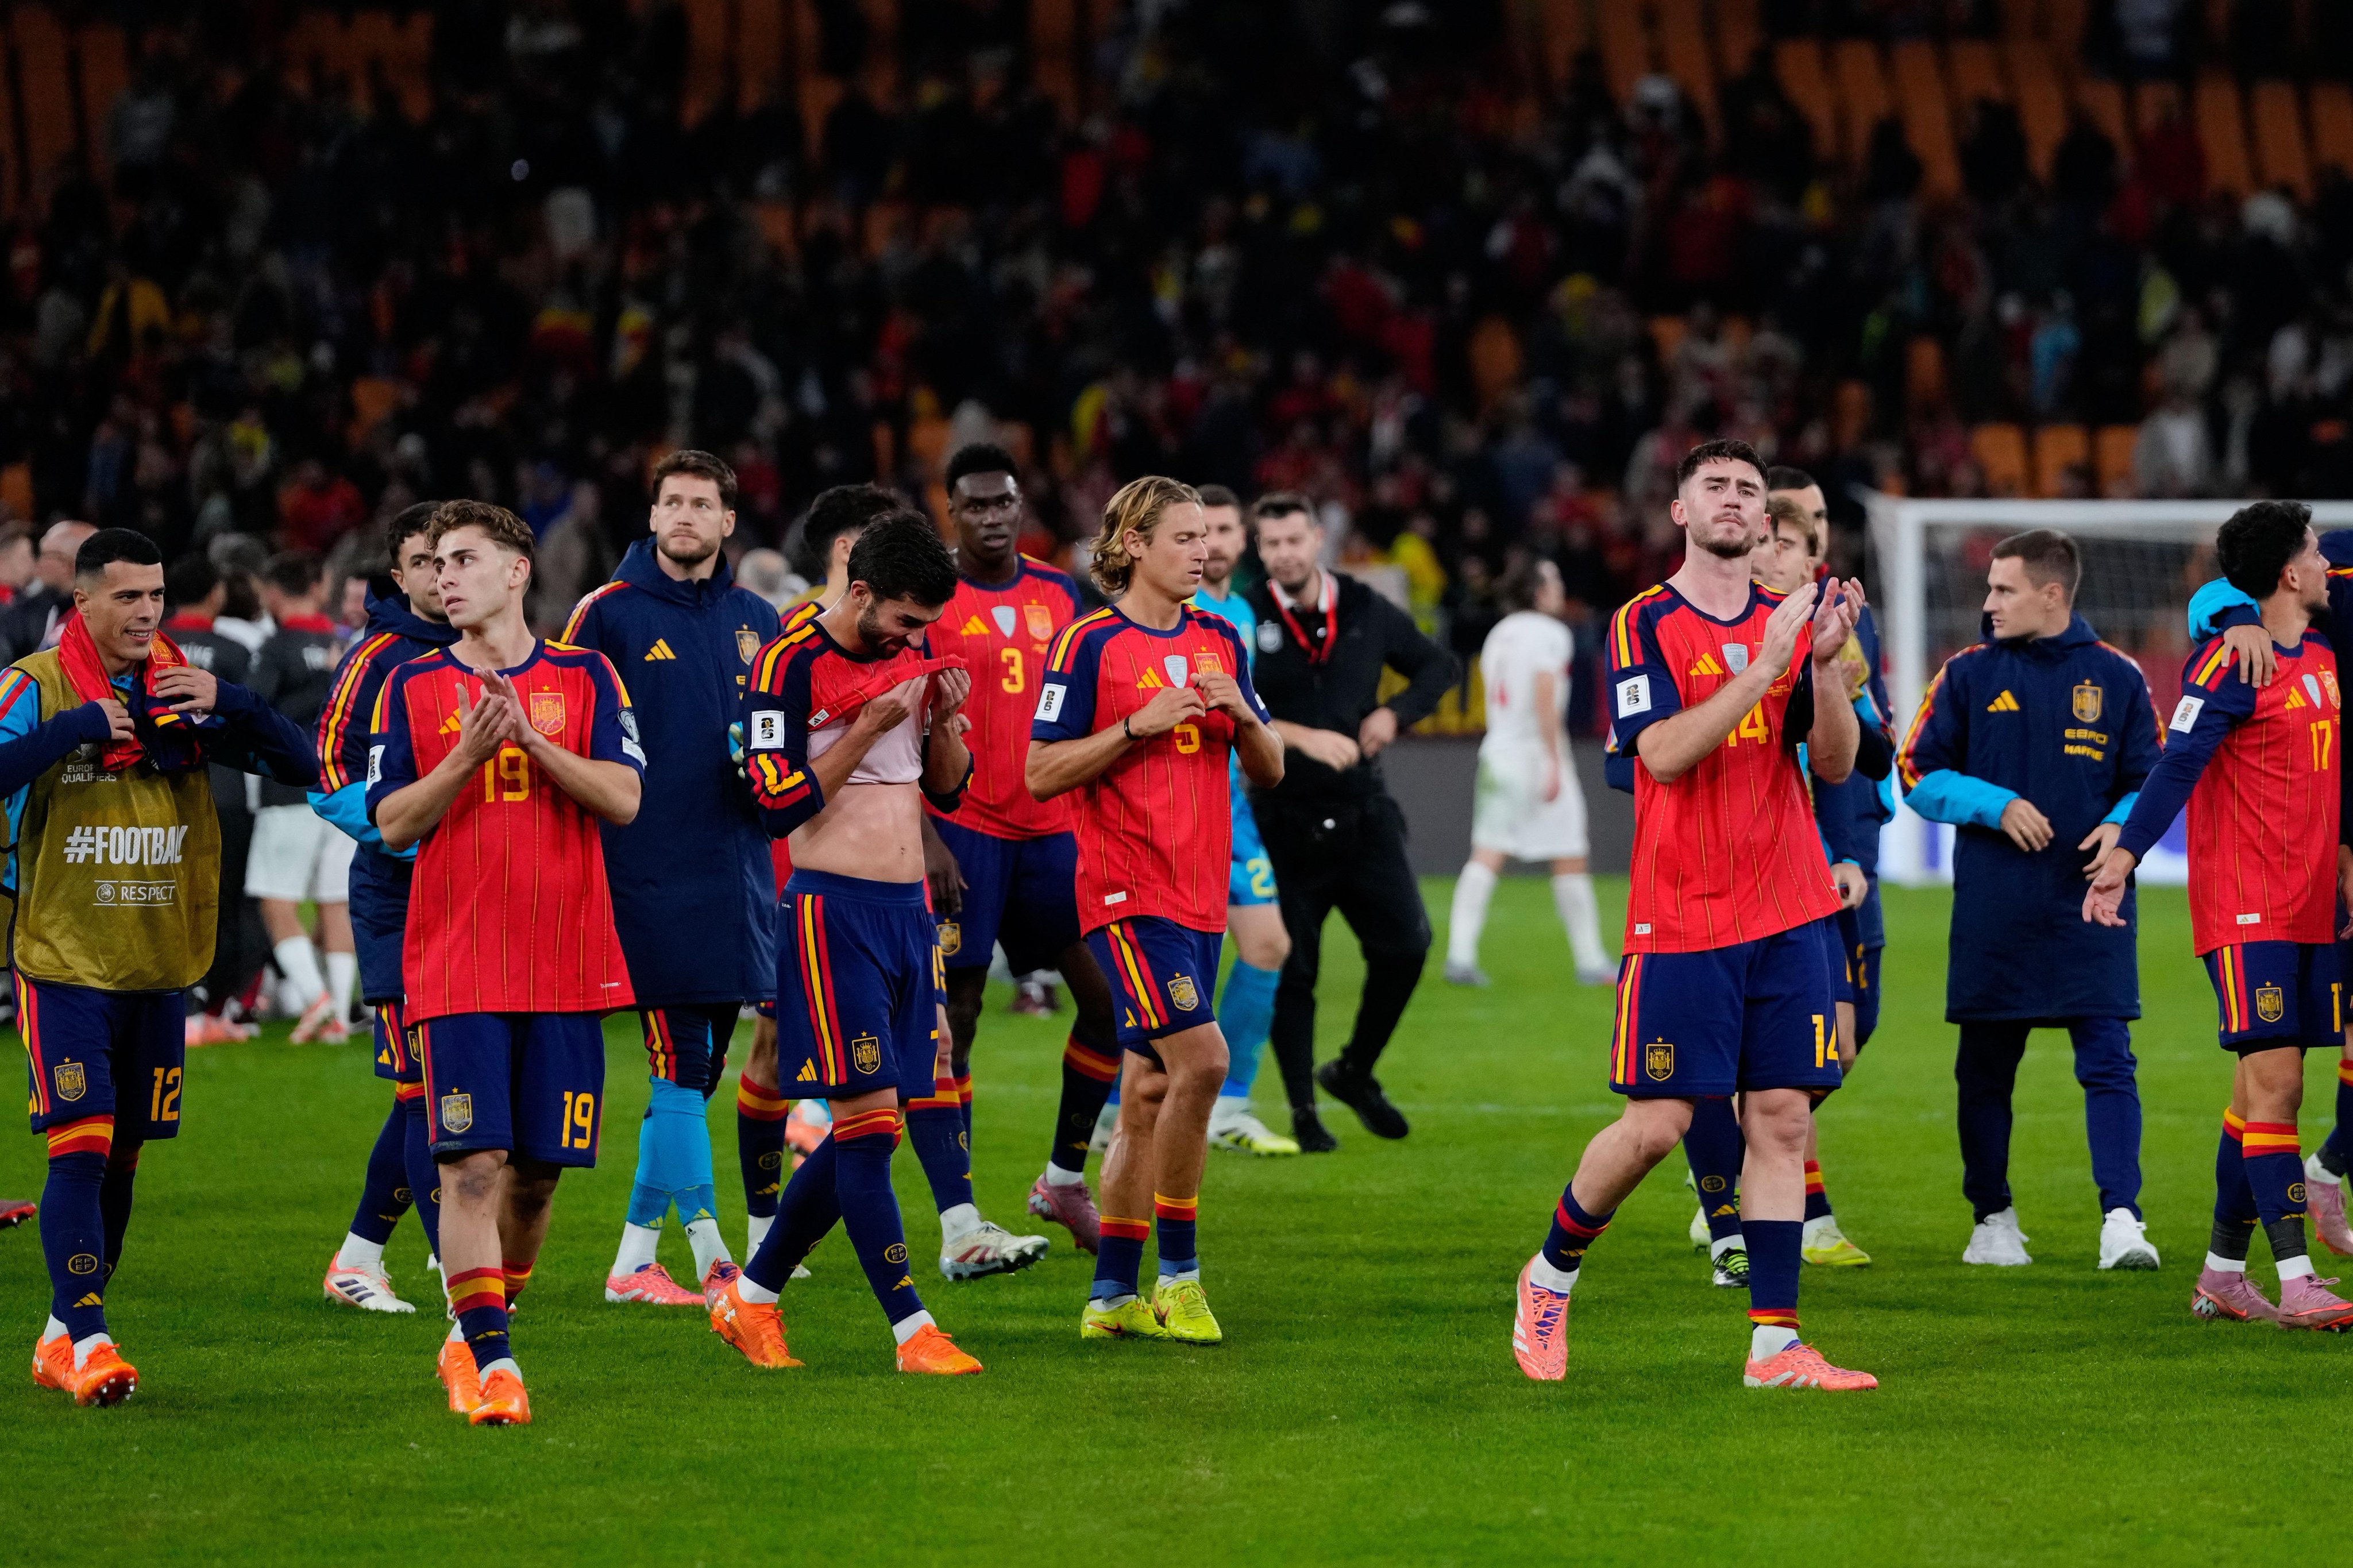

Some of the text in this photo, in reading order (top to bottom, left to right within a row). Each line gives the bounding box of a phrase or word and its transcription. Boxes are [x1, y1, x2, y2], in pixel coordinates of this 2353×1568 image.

[1000, 647, 1025, 694] 3
[2310, 720, 2332, 772] 17
[61, 773, 117, 784] QUALIFIERS
[485, 747, 529, 802] 19
[121, 886, 175, 901] RESPECT
[2331, 983, 2342, 1032] 1
[151, 1067, 182, 1121] 12
[562, 1091, 594, 1149] 19
